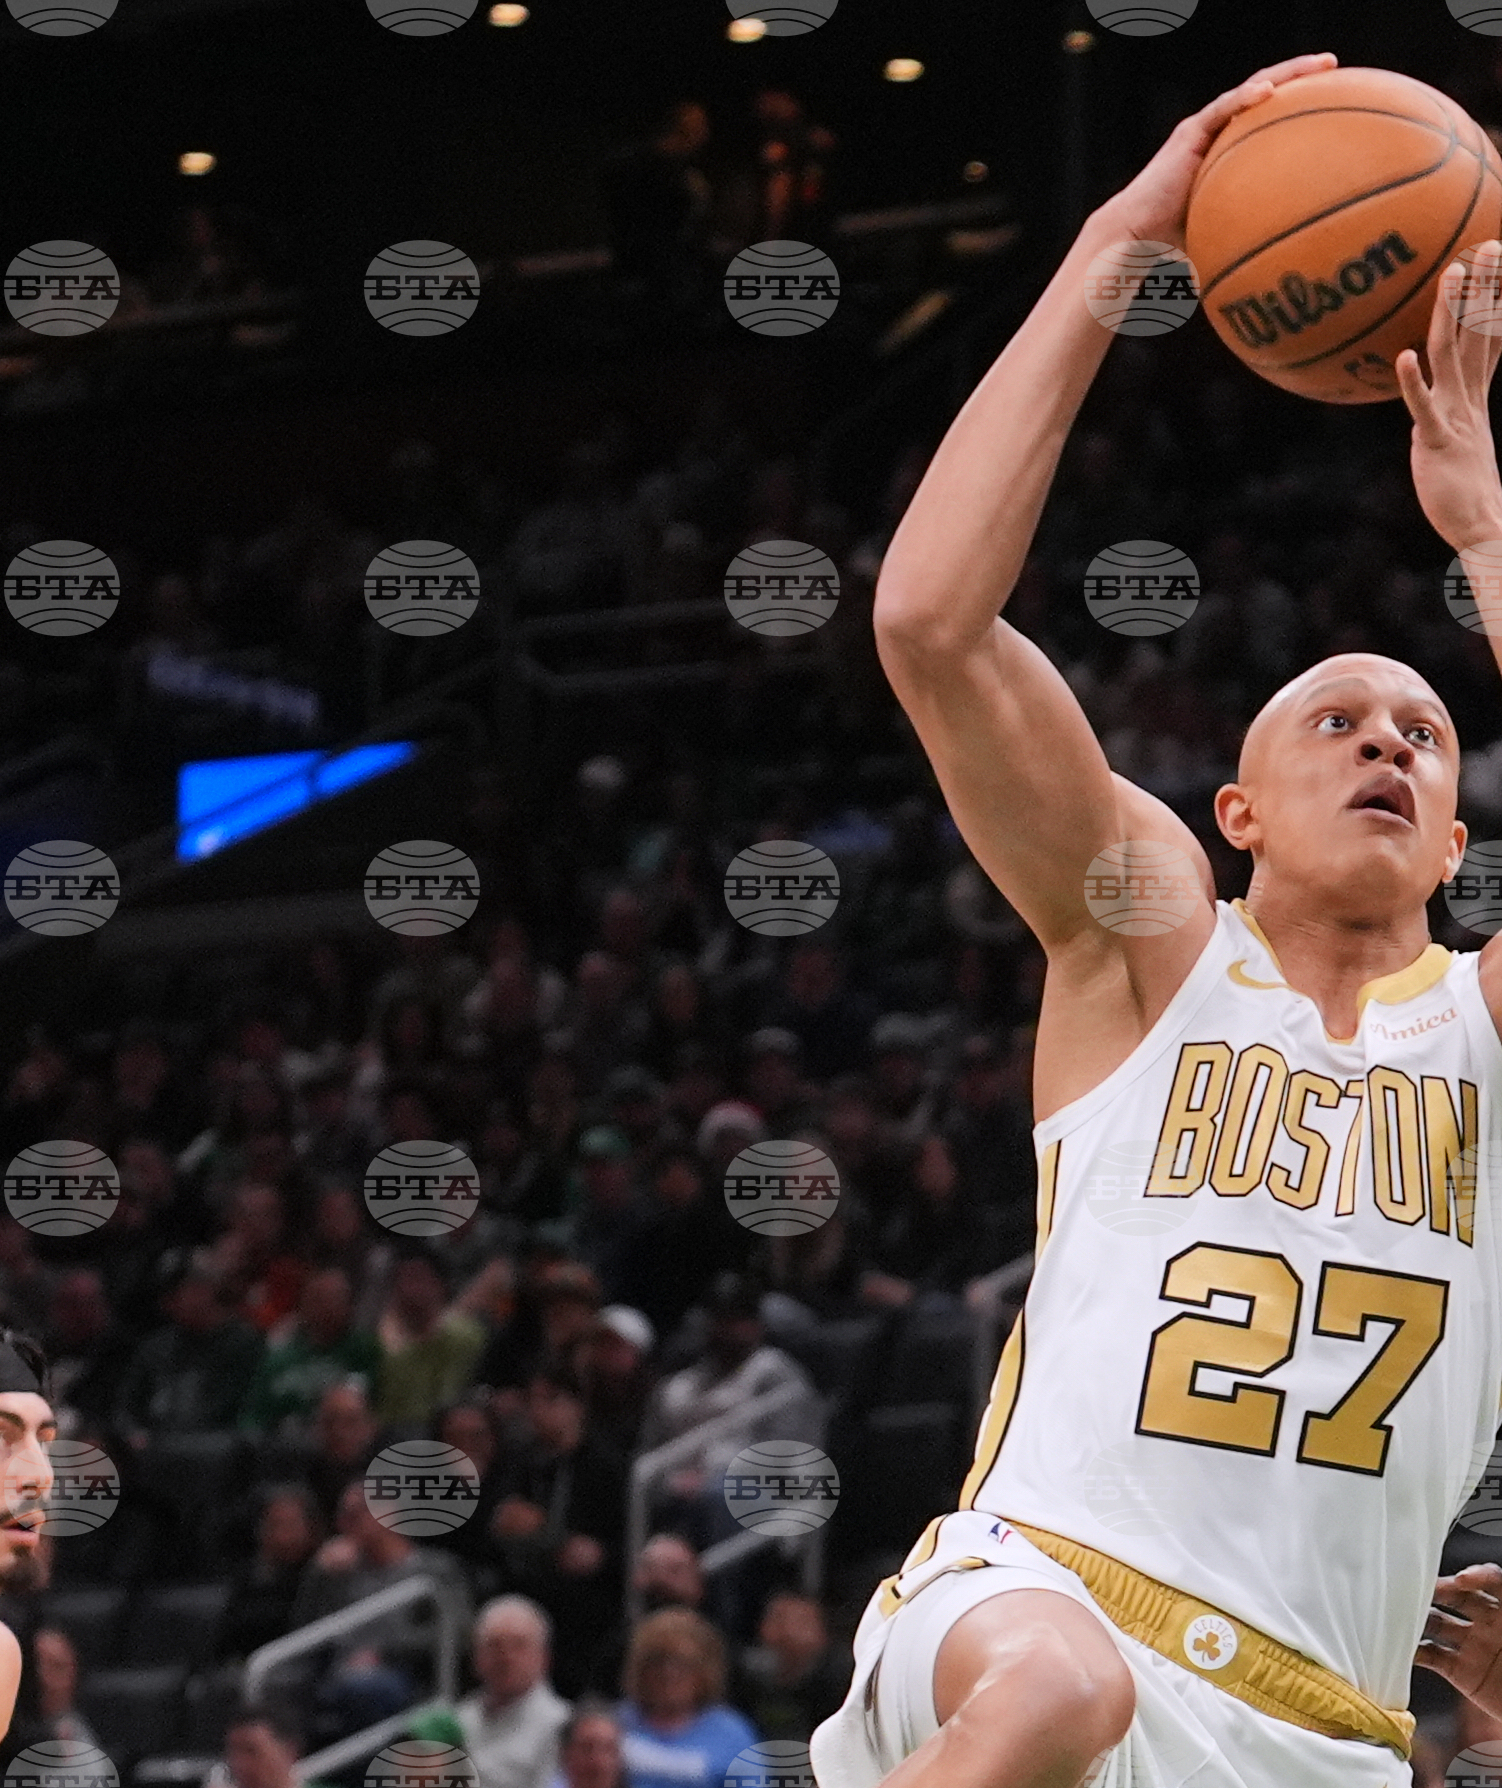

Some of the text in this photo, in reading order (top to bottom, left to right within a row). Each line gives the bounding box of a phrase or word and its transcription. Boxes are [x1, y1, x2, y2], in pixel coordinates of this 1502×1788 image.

[1219, 230, 1418, 347] Wilson
[1143, 1041, 1479, 1249] BOSTON
[1134, 1240, 1451, 1478] 27
[1194, 1619, 1233, 1648] CELTICS
